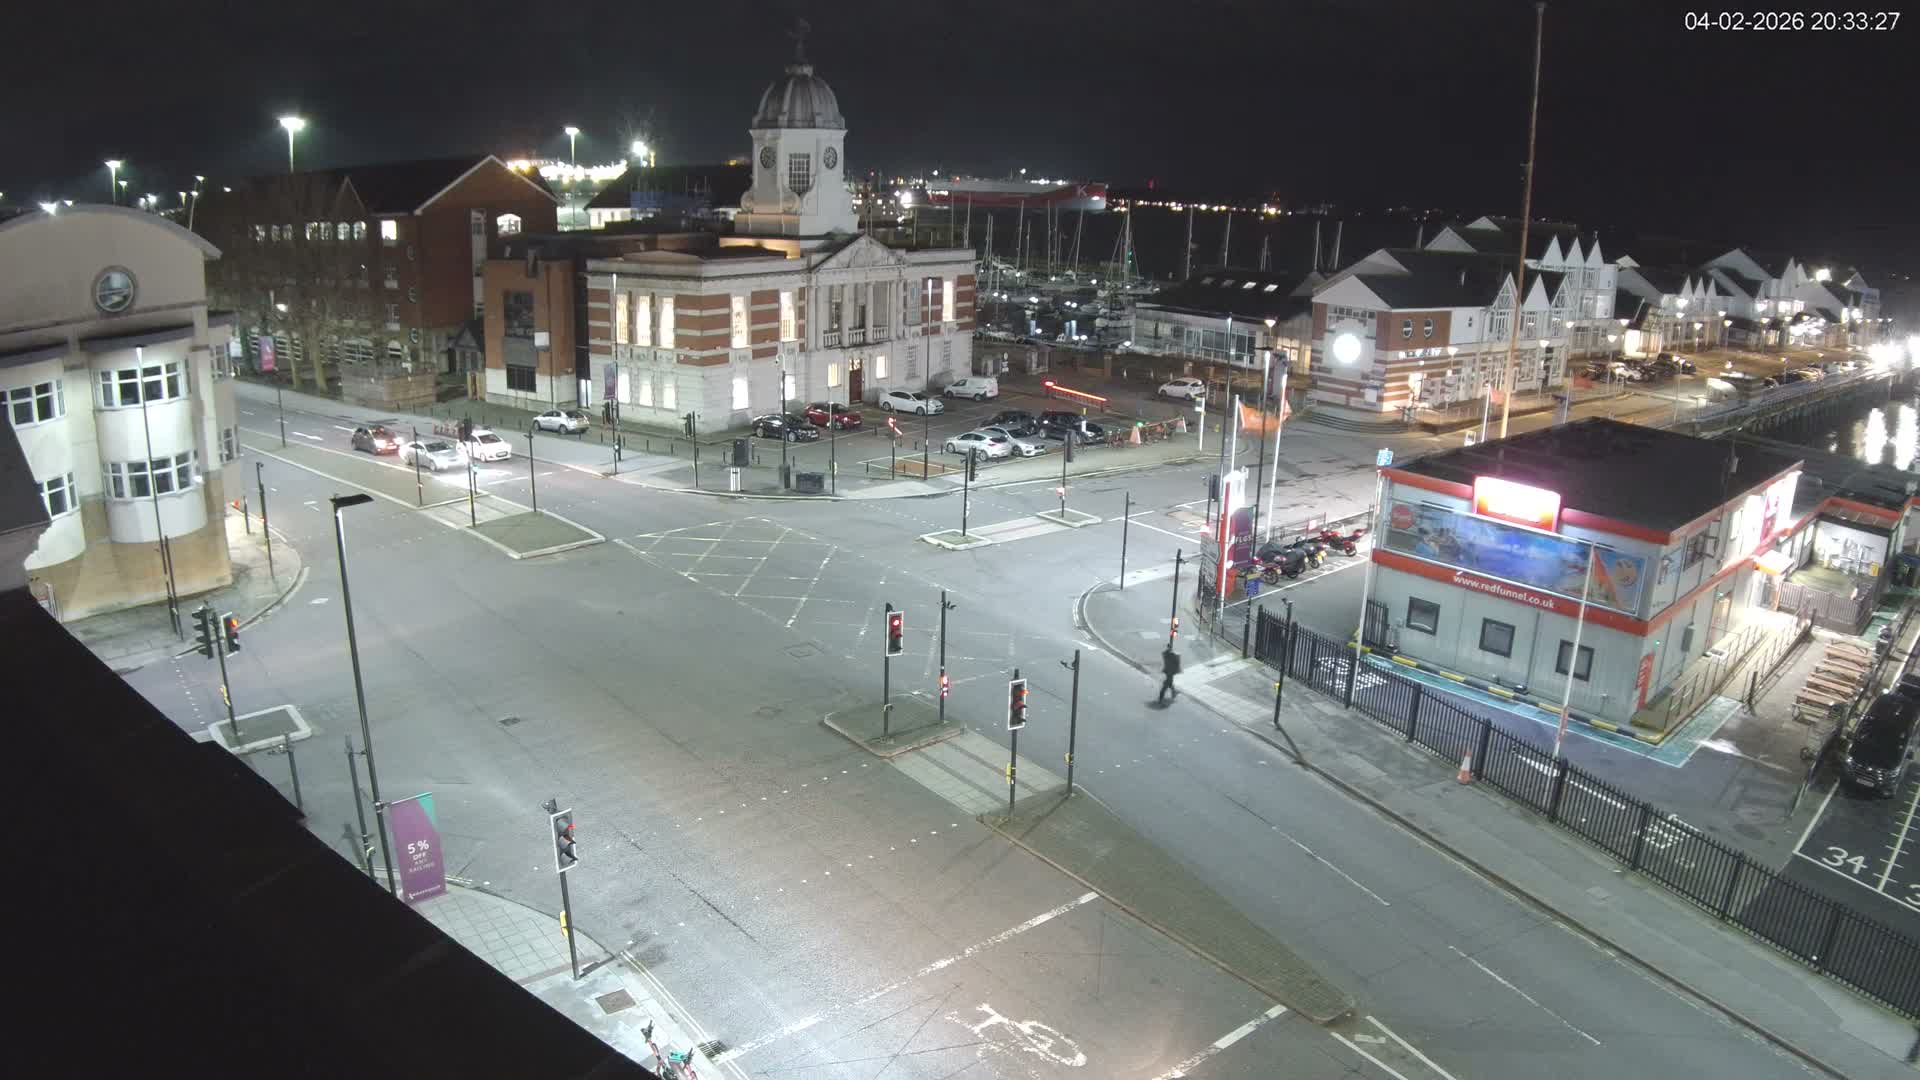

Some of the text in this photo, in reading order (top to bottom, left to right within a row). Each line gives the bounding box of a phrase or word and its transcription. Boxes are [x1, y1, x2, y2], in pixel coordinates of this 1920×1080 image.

[1453, 575, 1554, 608] www.redfunnel.co.uk
[413, 852, 427, 861] OFF
[1822, 846, 1868, 874] 34
